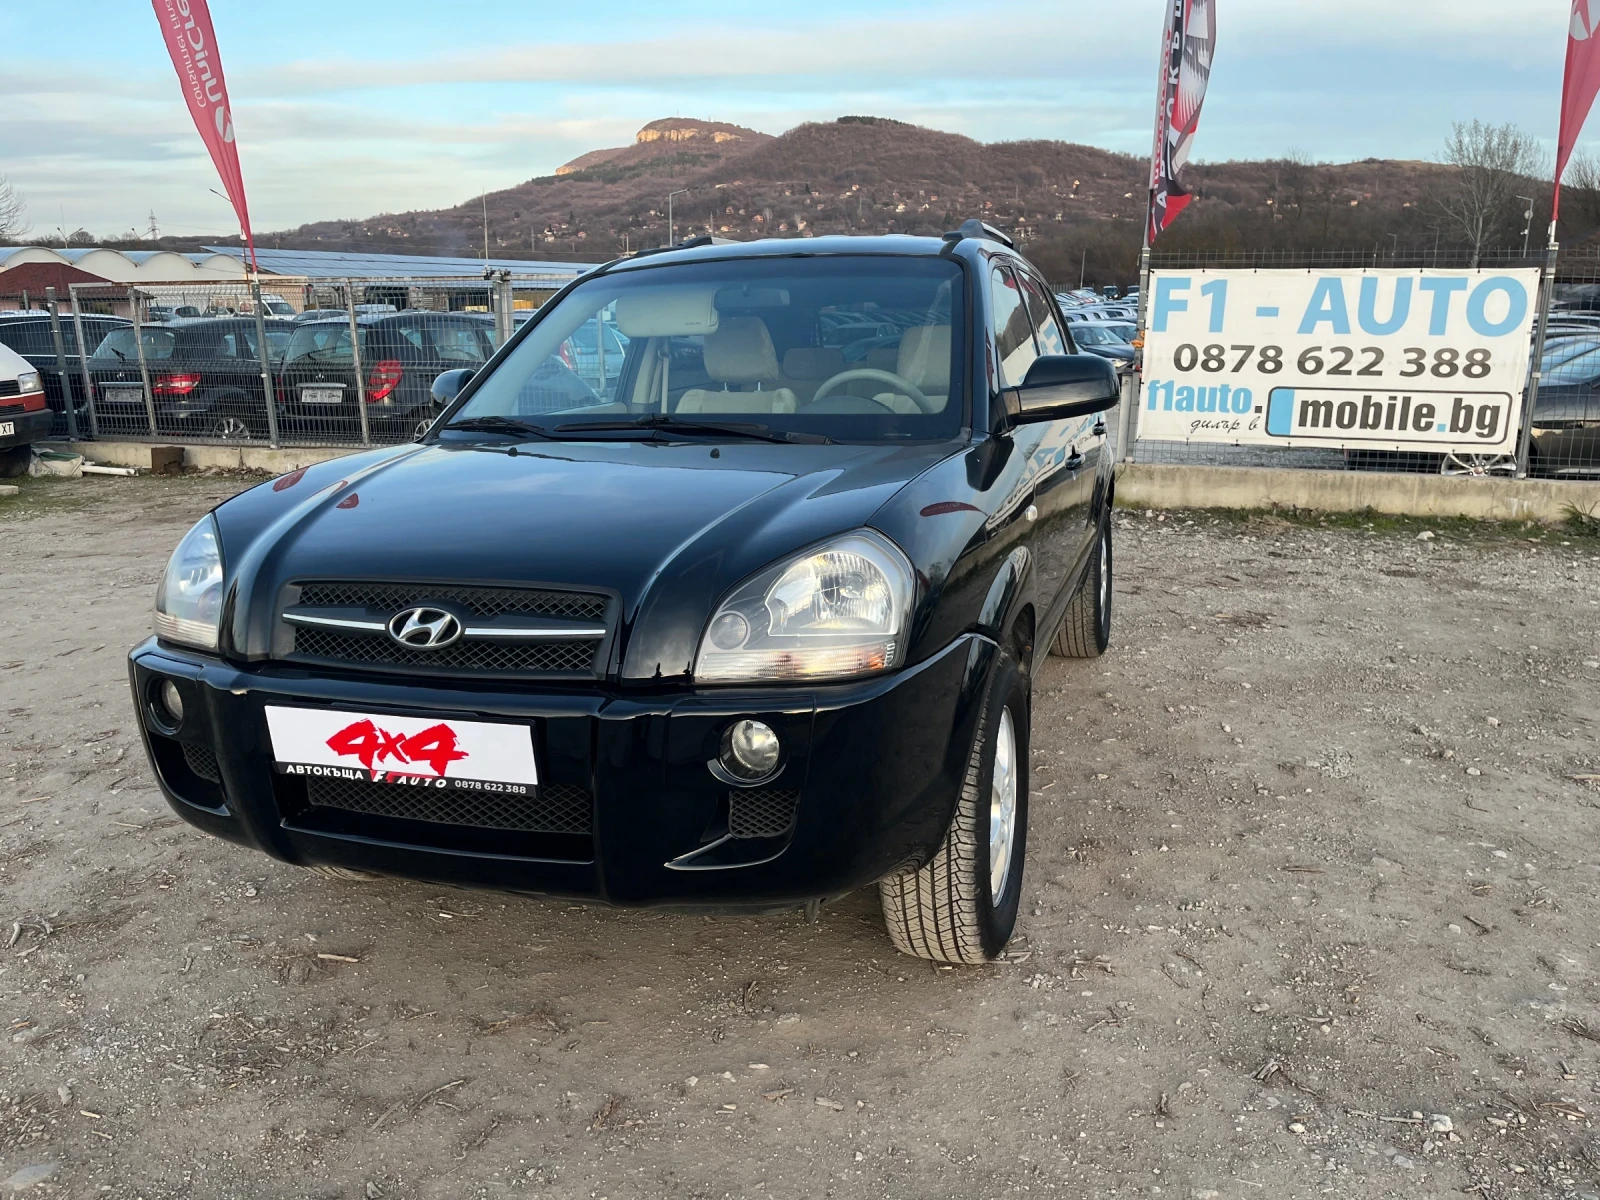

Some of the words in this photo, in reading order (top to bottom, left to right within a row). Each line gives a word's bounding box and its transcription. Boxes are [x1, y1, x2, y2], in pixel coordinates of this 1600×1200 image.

[1152, 277, 1228, 333] F1
[1297, 276, 1528, 337] AUTO
[1173, 343, 1283, 374] 0878
[1297, 345, 1384, 375] 622
[1399, 347, 1492, 378] 388
[1298, 395, 1500, 438] mobile.bg
[285, 765, 364, 780] АВТОКЪЩА
[397, 775, 447, 788] AUTO
[454, 779, 482, 790] 0878
[484, 782, 504, 792] 622
[505, 784, 526, 794] 388
